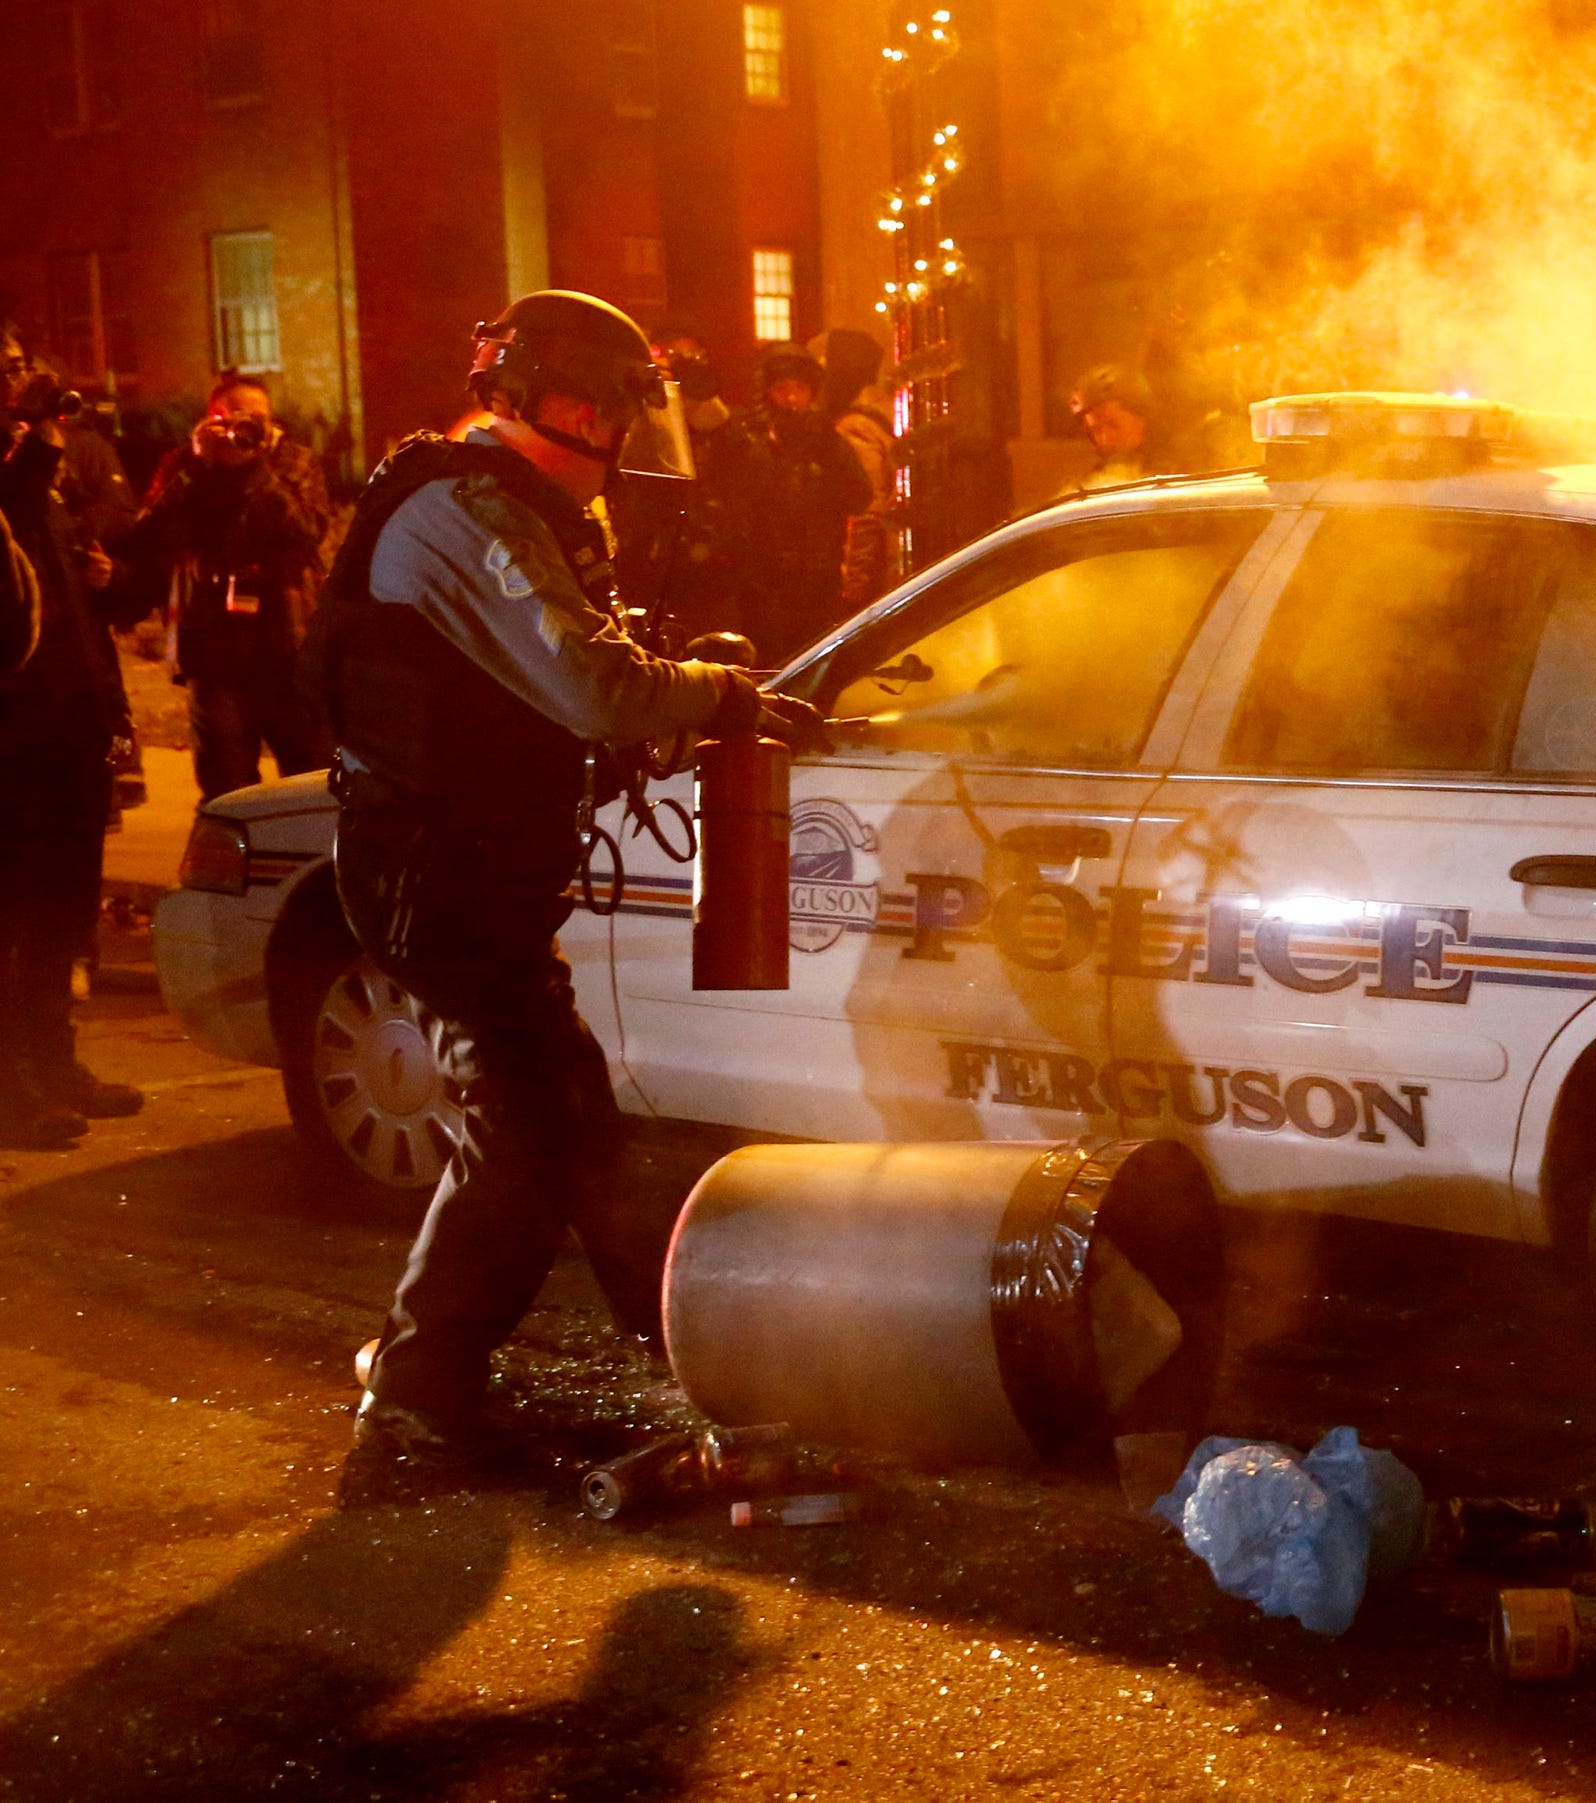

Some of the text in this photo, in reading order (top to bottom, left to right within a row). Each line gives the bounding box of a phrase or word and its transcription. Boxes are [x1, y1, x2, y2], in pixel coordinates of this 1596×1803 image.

[791, 886, 873, 913] GUSON
[902, 873, 1471, 1004] POLICE
[940, 1041, 1428, 1147] FERGUSON
